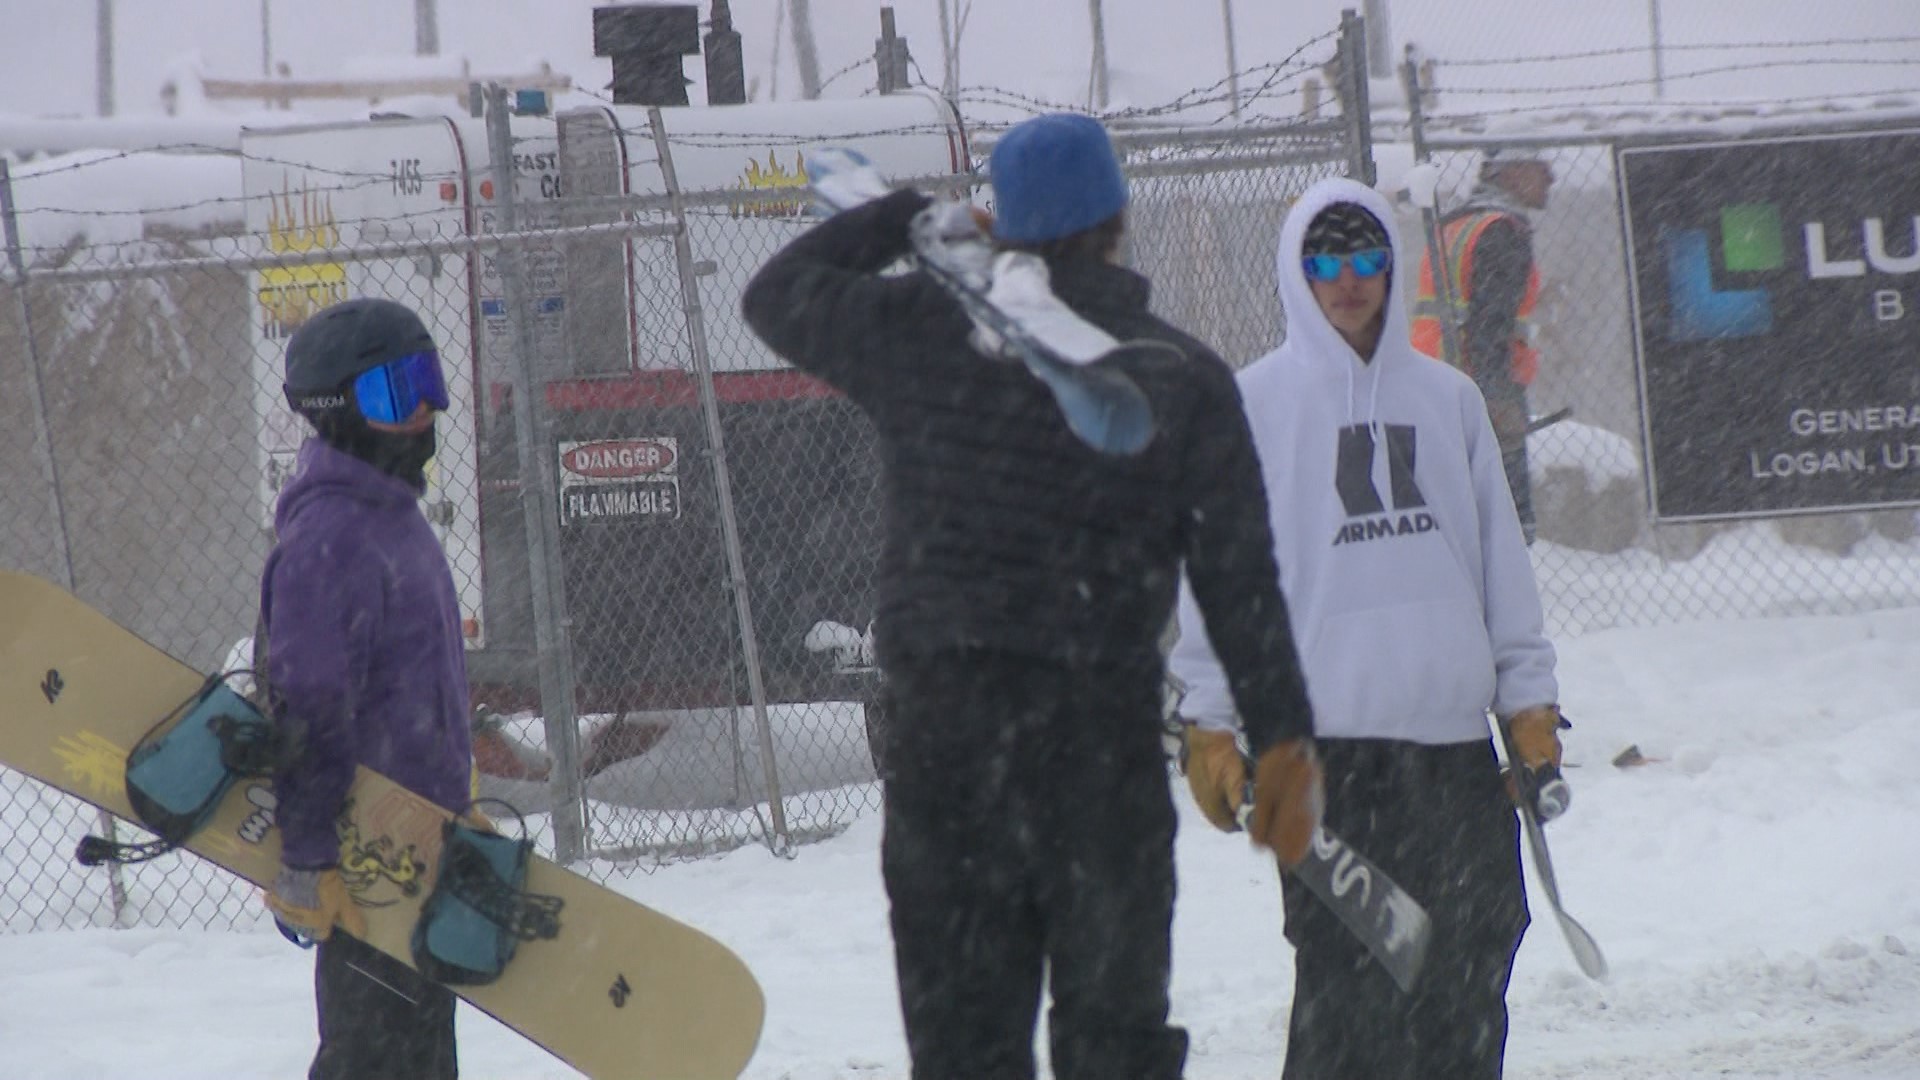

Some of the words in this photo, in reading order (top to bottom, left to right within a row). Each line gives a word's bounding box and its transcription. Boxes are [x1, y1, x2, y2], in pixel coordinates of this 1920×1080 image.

[512, 153, 557, 170] FAST
[390, 159, 421, 196] 7455
[1804, 215, 1920, 278] LU
[1875, 290, 1904, 320] B
[575, 447, 660, 470] DANGER
[1750, 448, 1877, 478] LOGAN,
[569, 490, 672, 518] FLAMMABLE
